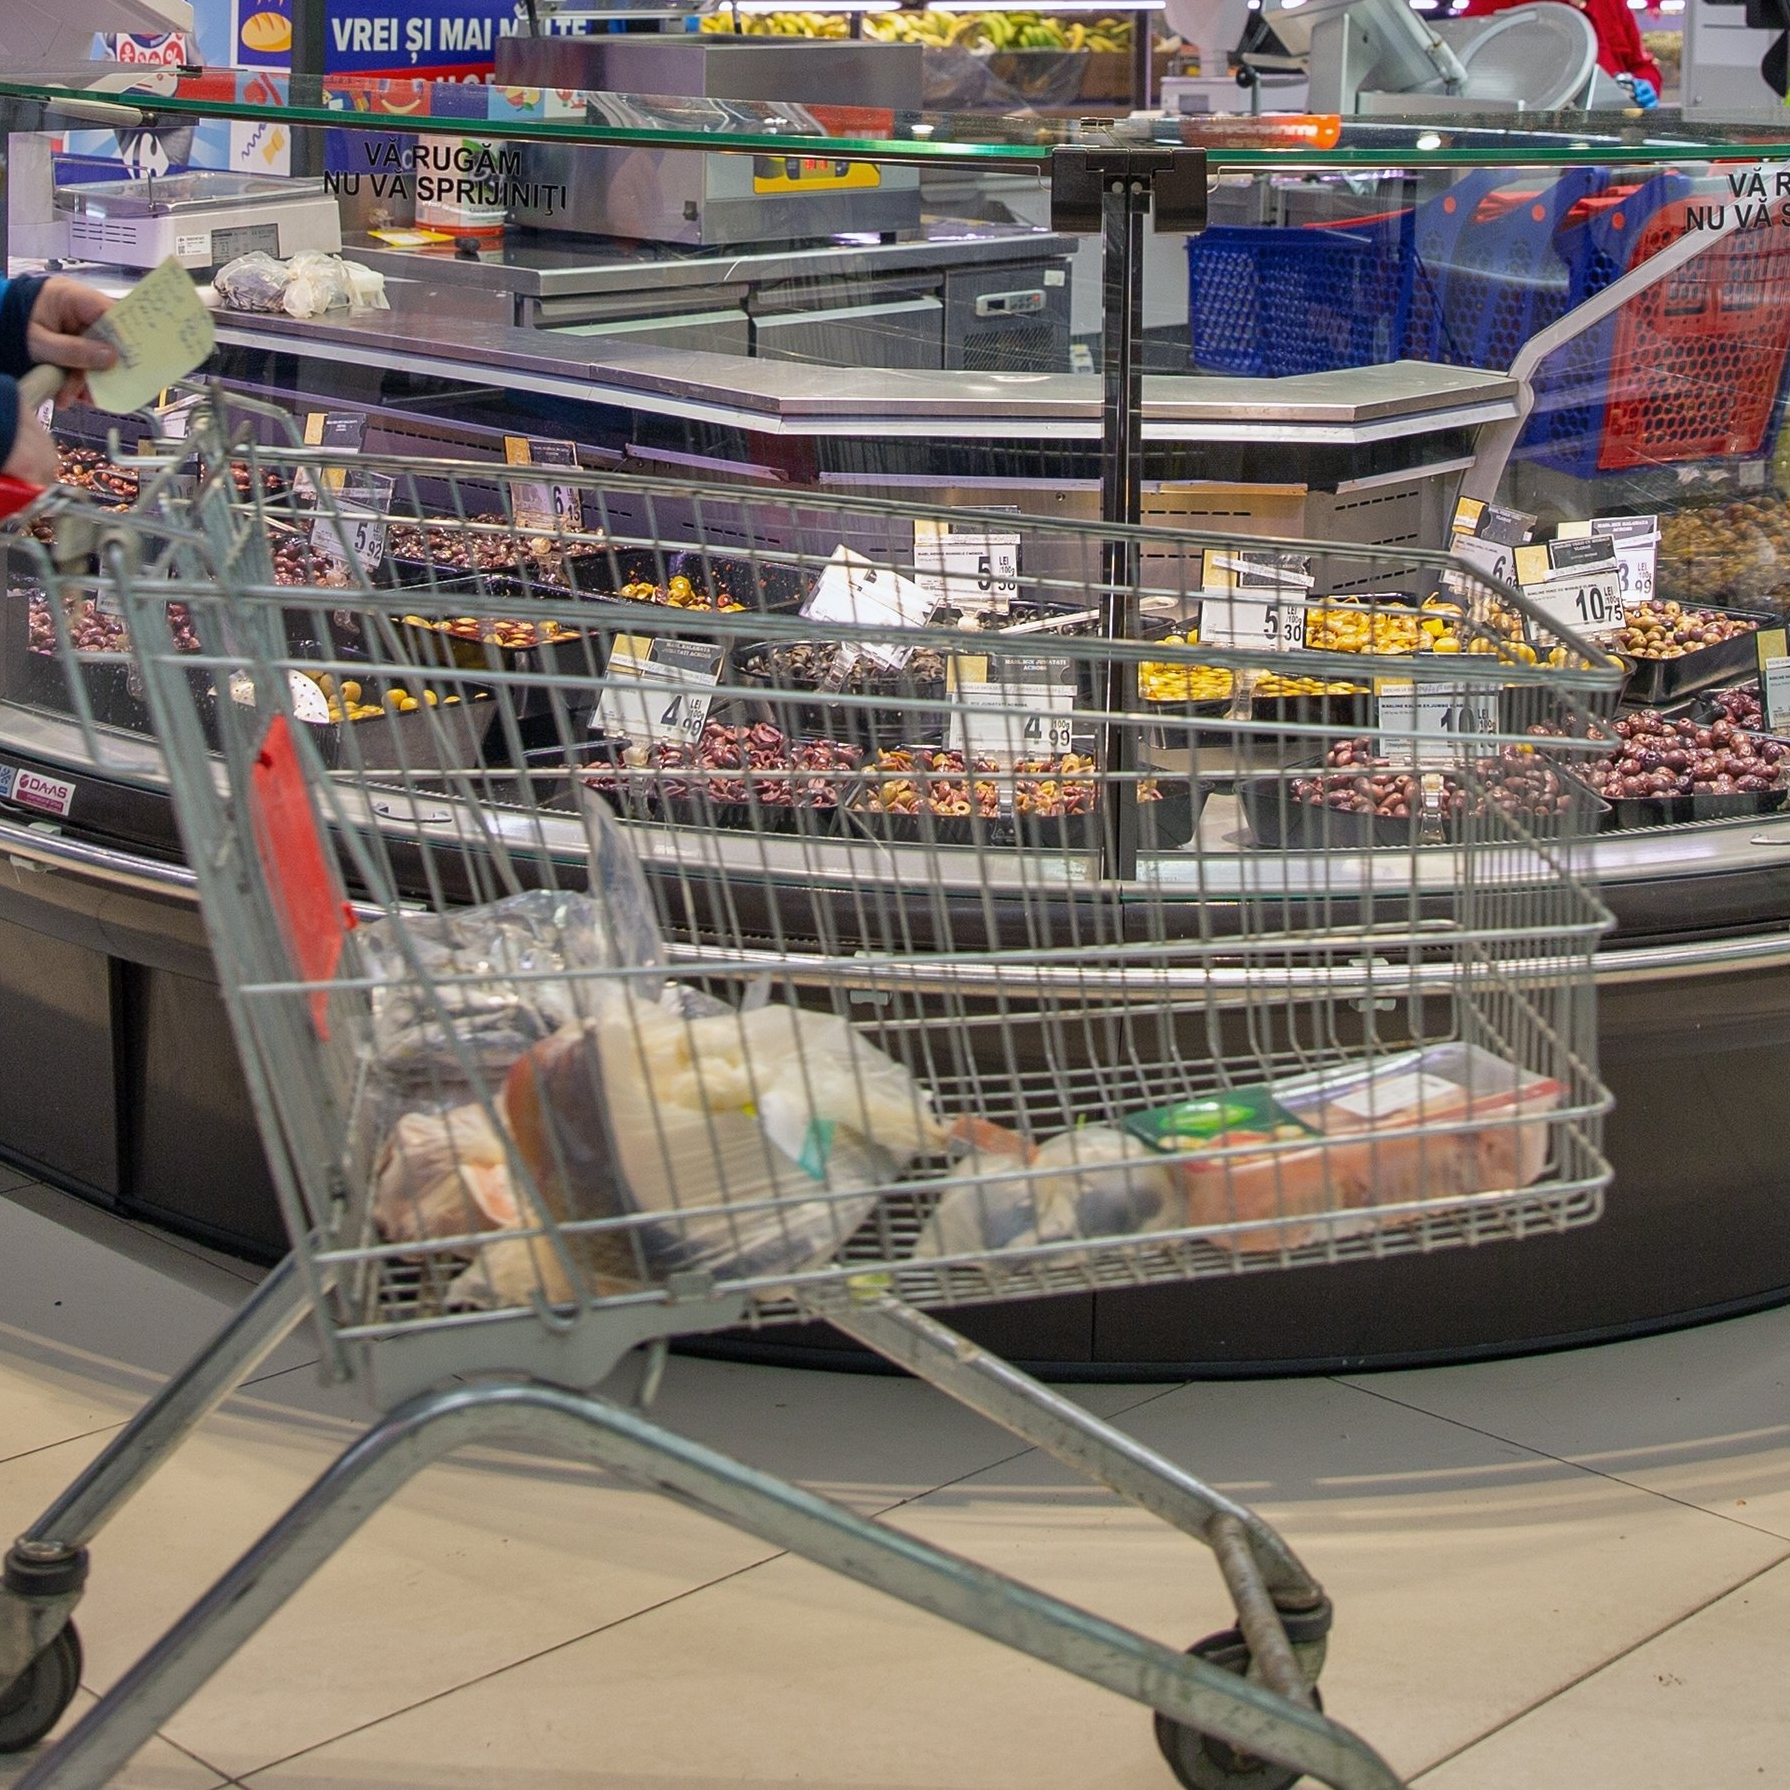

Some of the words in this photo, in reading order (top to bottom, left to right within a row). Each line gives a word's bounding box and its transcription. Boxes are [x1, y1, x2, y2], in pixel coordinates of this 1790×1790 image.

[330, 16, 399, 53] VREI
[439, 16, 492, 52] MAI
[364, 136, 402, 168] VĂ
[412, 142, 522, 176] RUGĂM
[323, 170, 361, 197] NU
[370, 169, 408, 200] VĂ
[1728, 164, 1767, 198] VĂ
[1686, 205, 1726, 232] NU
[1736, 199, 1773, 230] VĂ
[977, 556, 991, 591] 5
[998, 556, 1010, 566] LEI
[1635, 579, 1652, 595] 99
[1576, 587, 1606, 622] 10
[1604, 585, 1615, 596] LEI
[1605, 605, 1623, 622] 75
[1263, 606, 1279, 640] 5
[1284, 623, 1302, 642] 30
[660, 694, 683, 727] 4
[689, 698, 703, 710] LEI
[682, 717, 703, 737] 99
[1024, 712, 1043, 739] 4
[1048, 729, 1071, 747] 99
